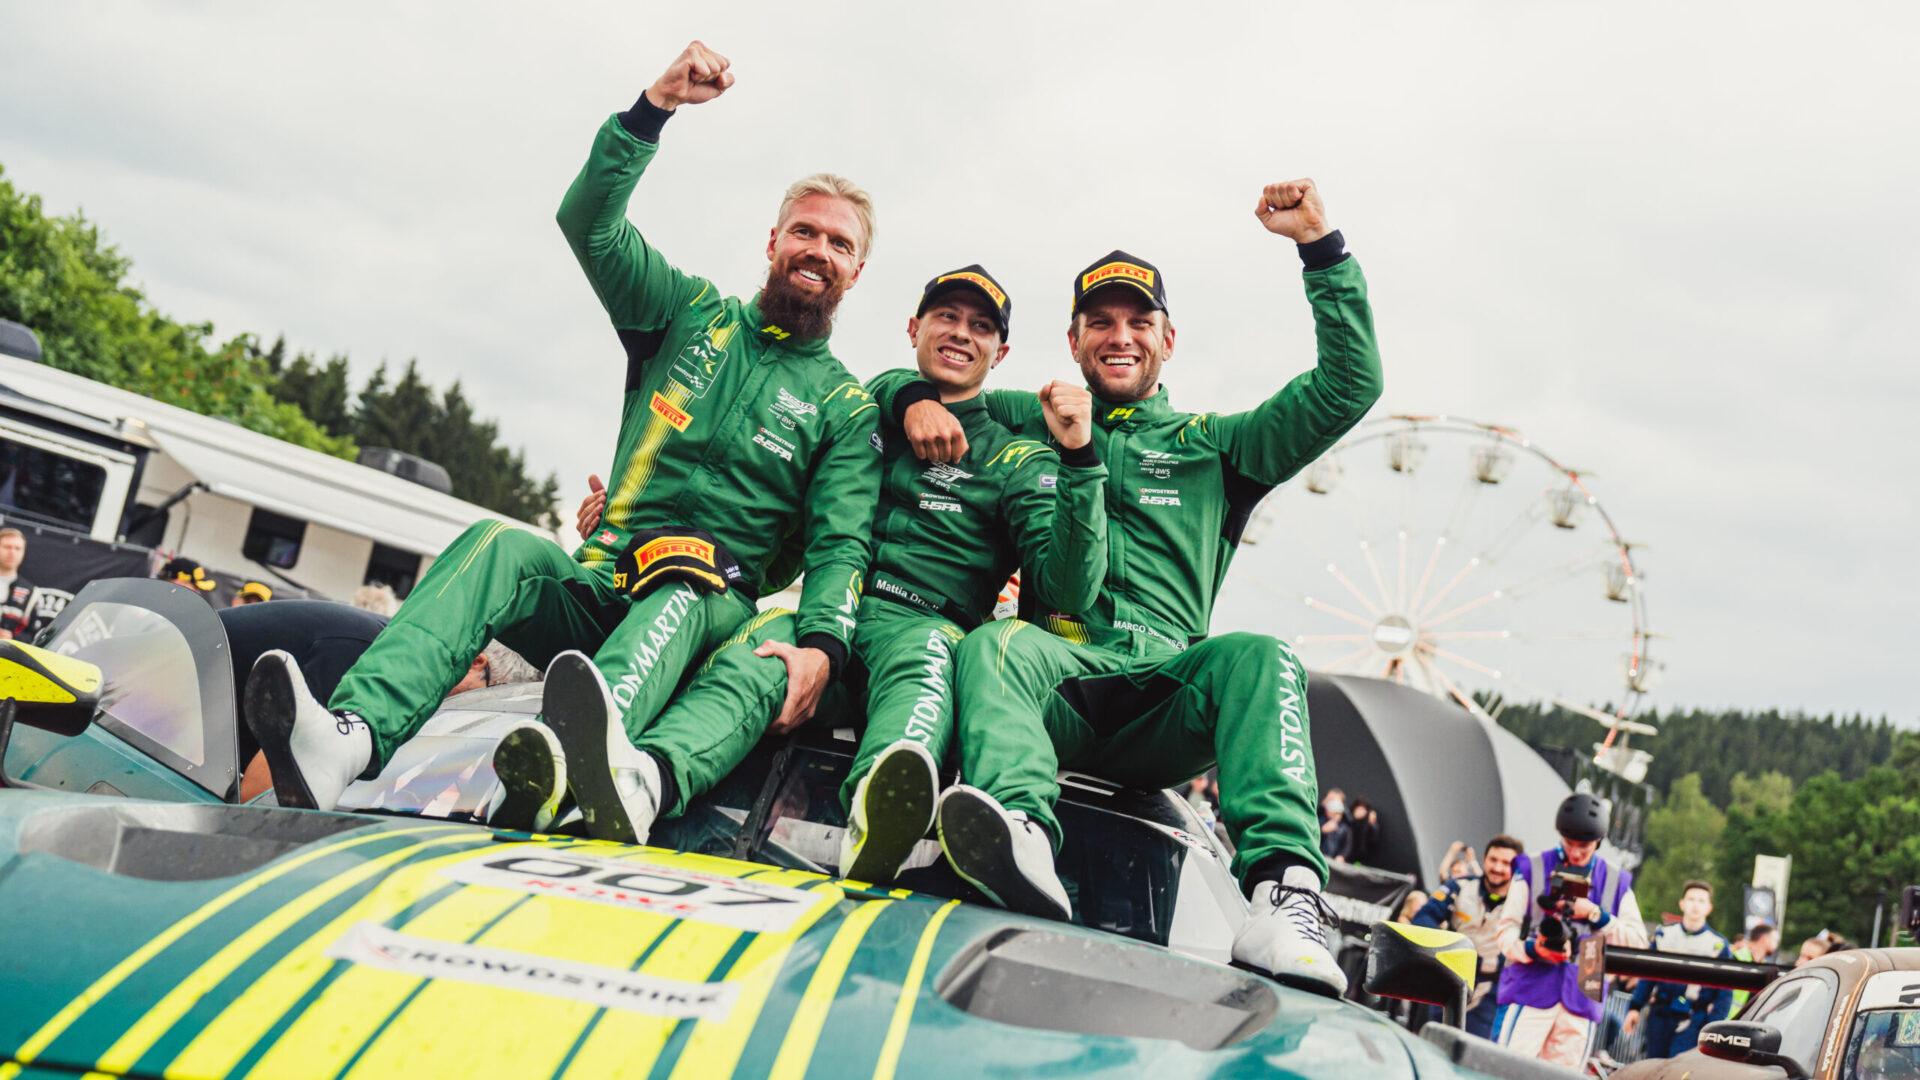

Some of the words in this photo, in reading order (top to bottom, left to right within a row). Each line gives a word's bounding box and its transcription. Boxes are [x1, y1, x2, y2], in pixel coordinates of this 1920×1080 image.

[1087, 265, 1149, 284] PIRELLI
[652, 395, 687, 427] PIRELLI
[640, 539, 710, 567] PIRELLI
[875, 578, 908, 599] Mattia
[633, 580, 699, 677] MARTIN
[1113, 620, 1147, 634] MARCO
[904, 686, 944, 746] STON
[1279, 686, 1307, 785] ASTON
[482, 857, 800, 906] 007
[380, 943, 722, 1006] CROWDSTRIKE
[1704, 1032, 1752, 1048] AMG
